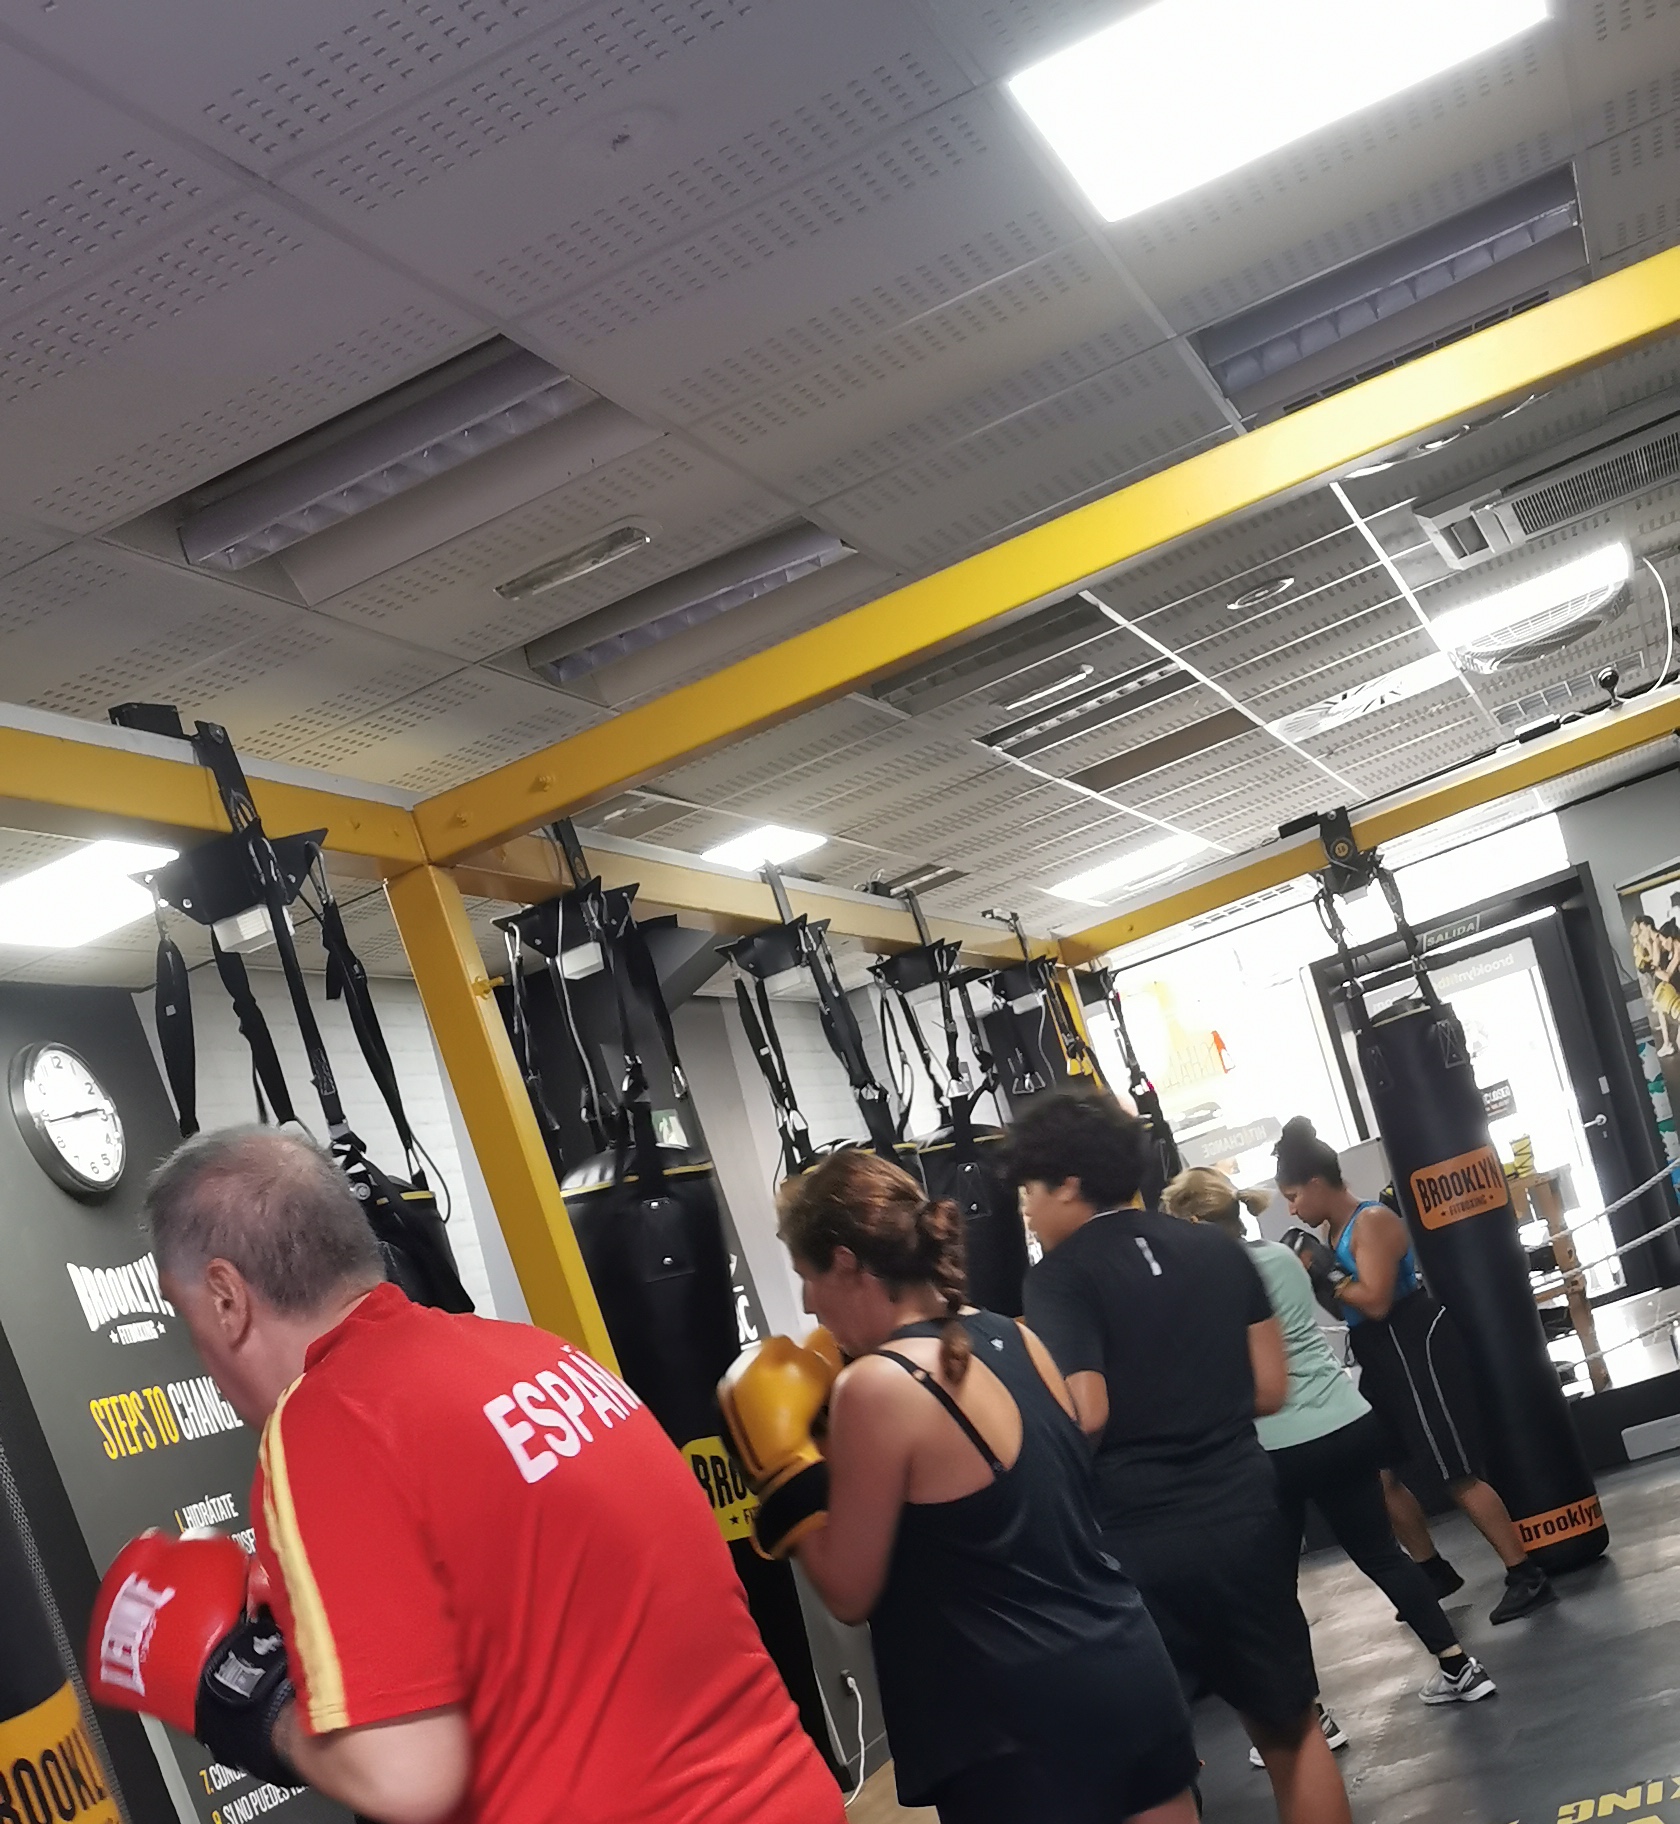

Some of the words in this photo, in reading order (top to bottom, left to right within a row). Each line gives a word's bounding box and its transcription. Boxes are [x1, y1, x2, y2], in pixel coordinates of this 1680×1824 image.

[1426, 921, 1475, 948] SALIDA
[1415, 1151, 1503, 1214] BROOKLYN
[90, 1390, 157, 1460] STEPS
[142, 1385, 180, 1446] TO
[483, 1345, 643, 1484] ESPAÑ
[182, 1492, 239, 1530] HIDRÁTATE
